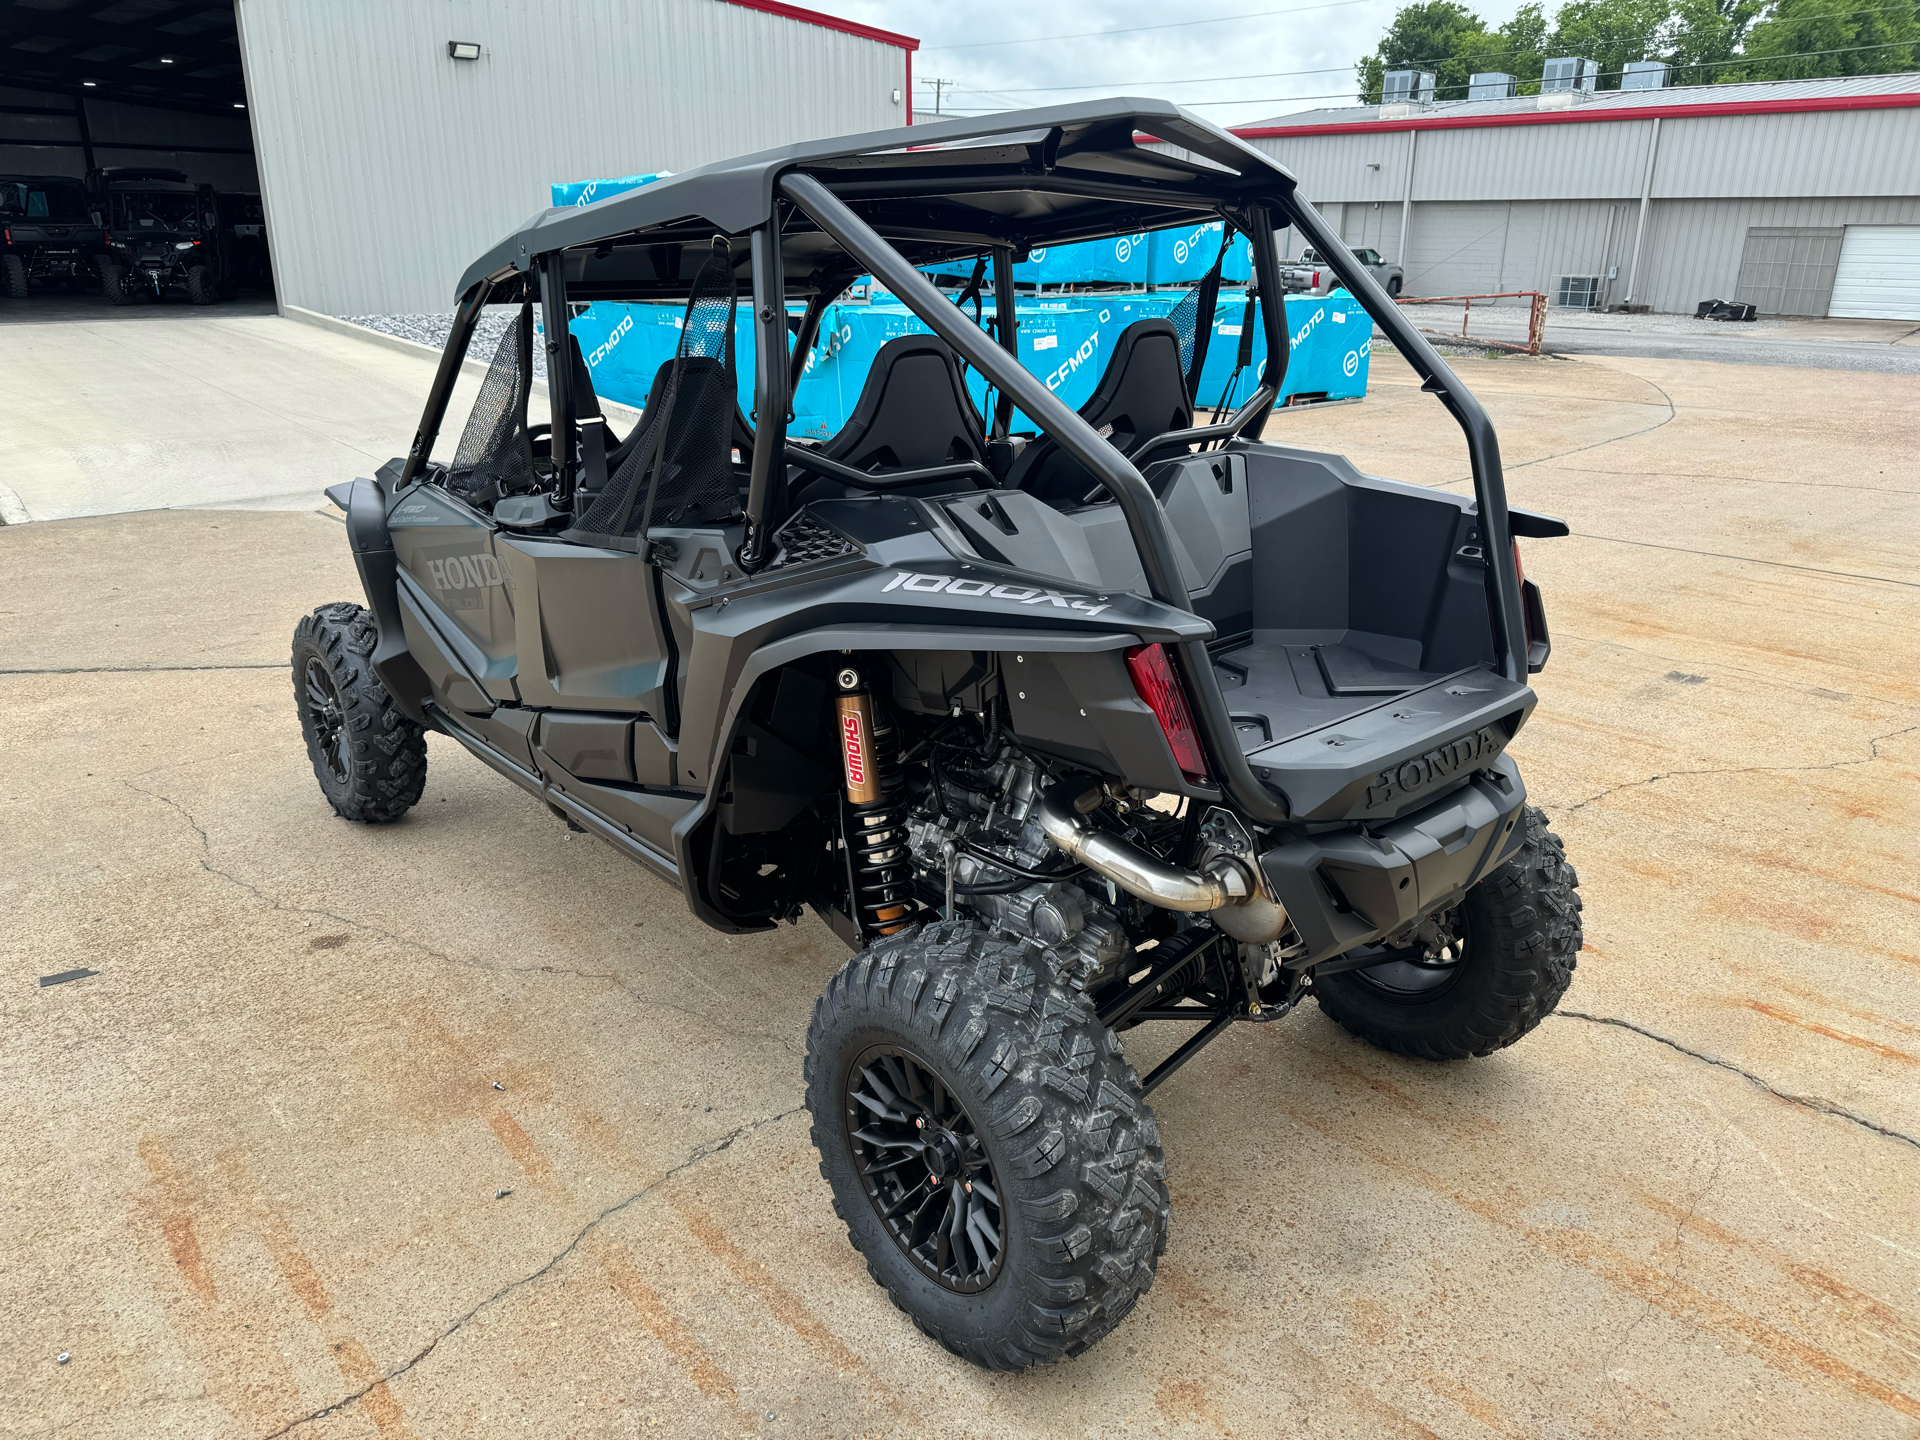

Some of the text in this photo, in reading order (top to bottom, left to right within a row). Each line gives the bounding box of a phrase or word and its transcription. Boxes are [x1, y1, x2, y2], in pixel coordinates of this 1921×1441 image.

[576, 182, 598, 207] OTO
[589, 314, 634, 368] CFMOTO
[1290, 307, 1325, 350] MOTO
[426, 552, 516, 591] HONDA
[881, 571, 1112, 617] 1000X4
[842, 714, 865, 785] SHOWA
[1366, 726, 1500, 810] HONDA
[823, 1119, 882, 1249] KENDA
